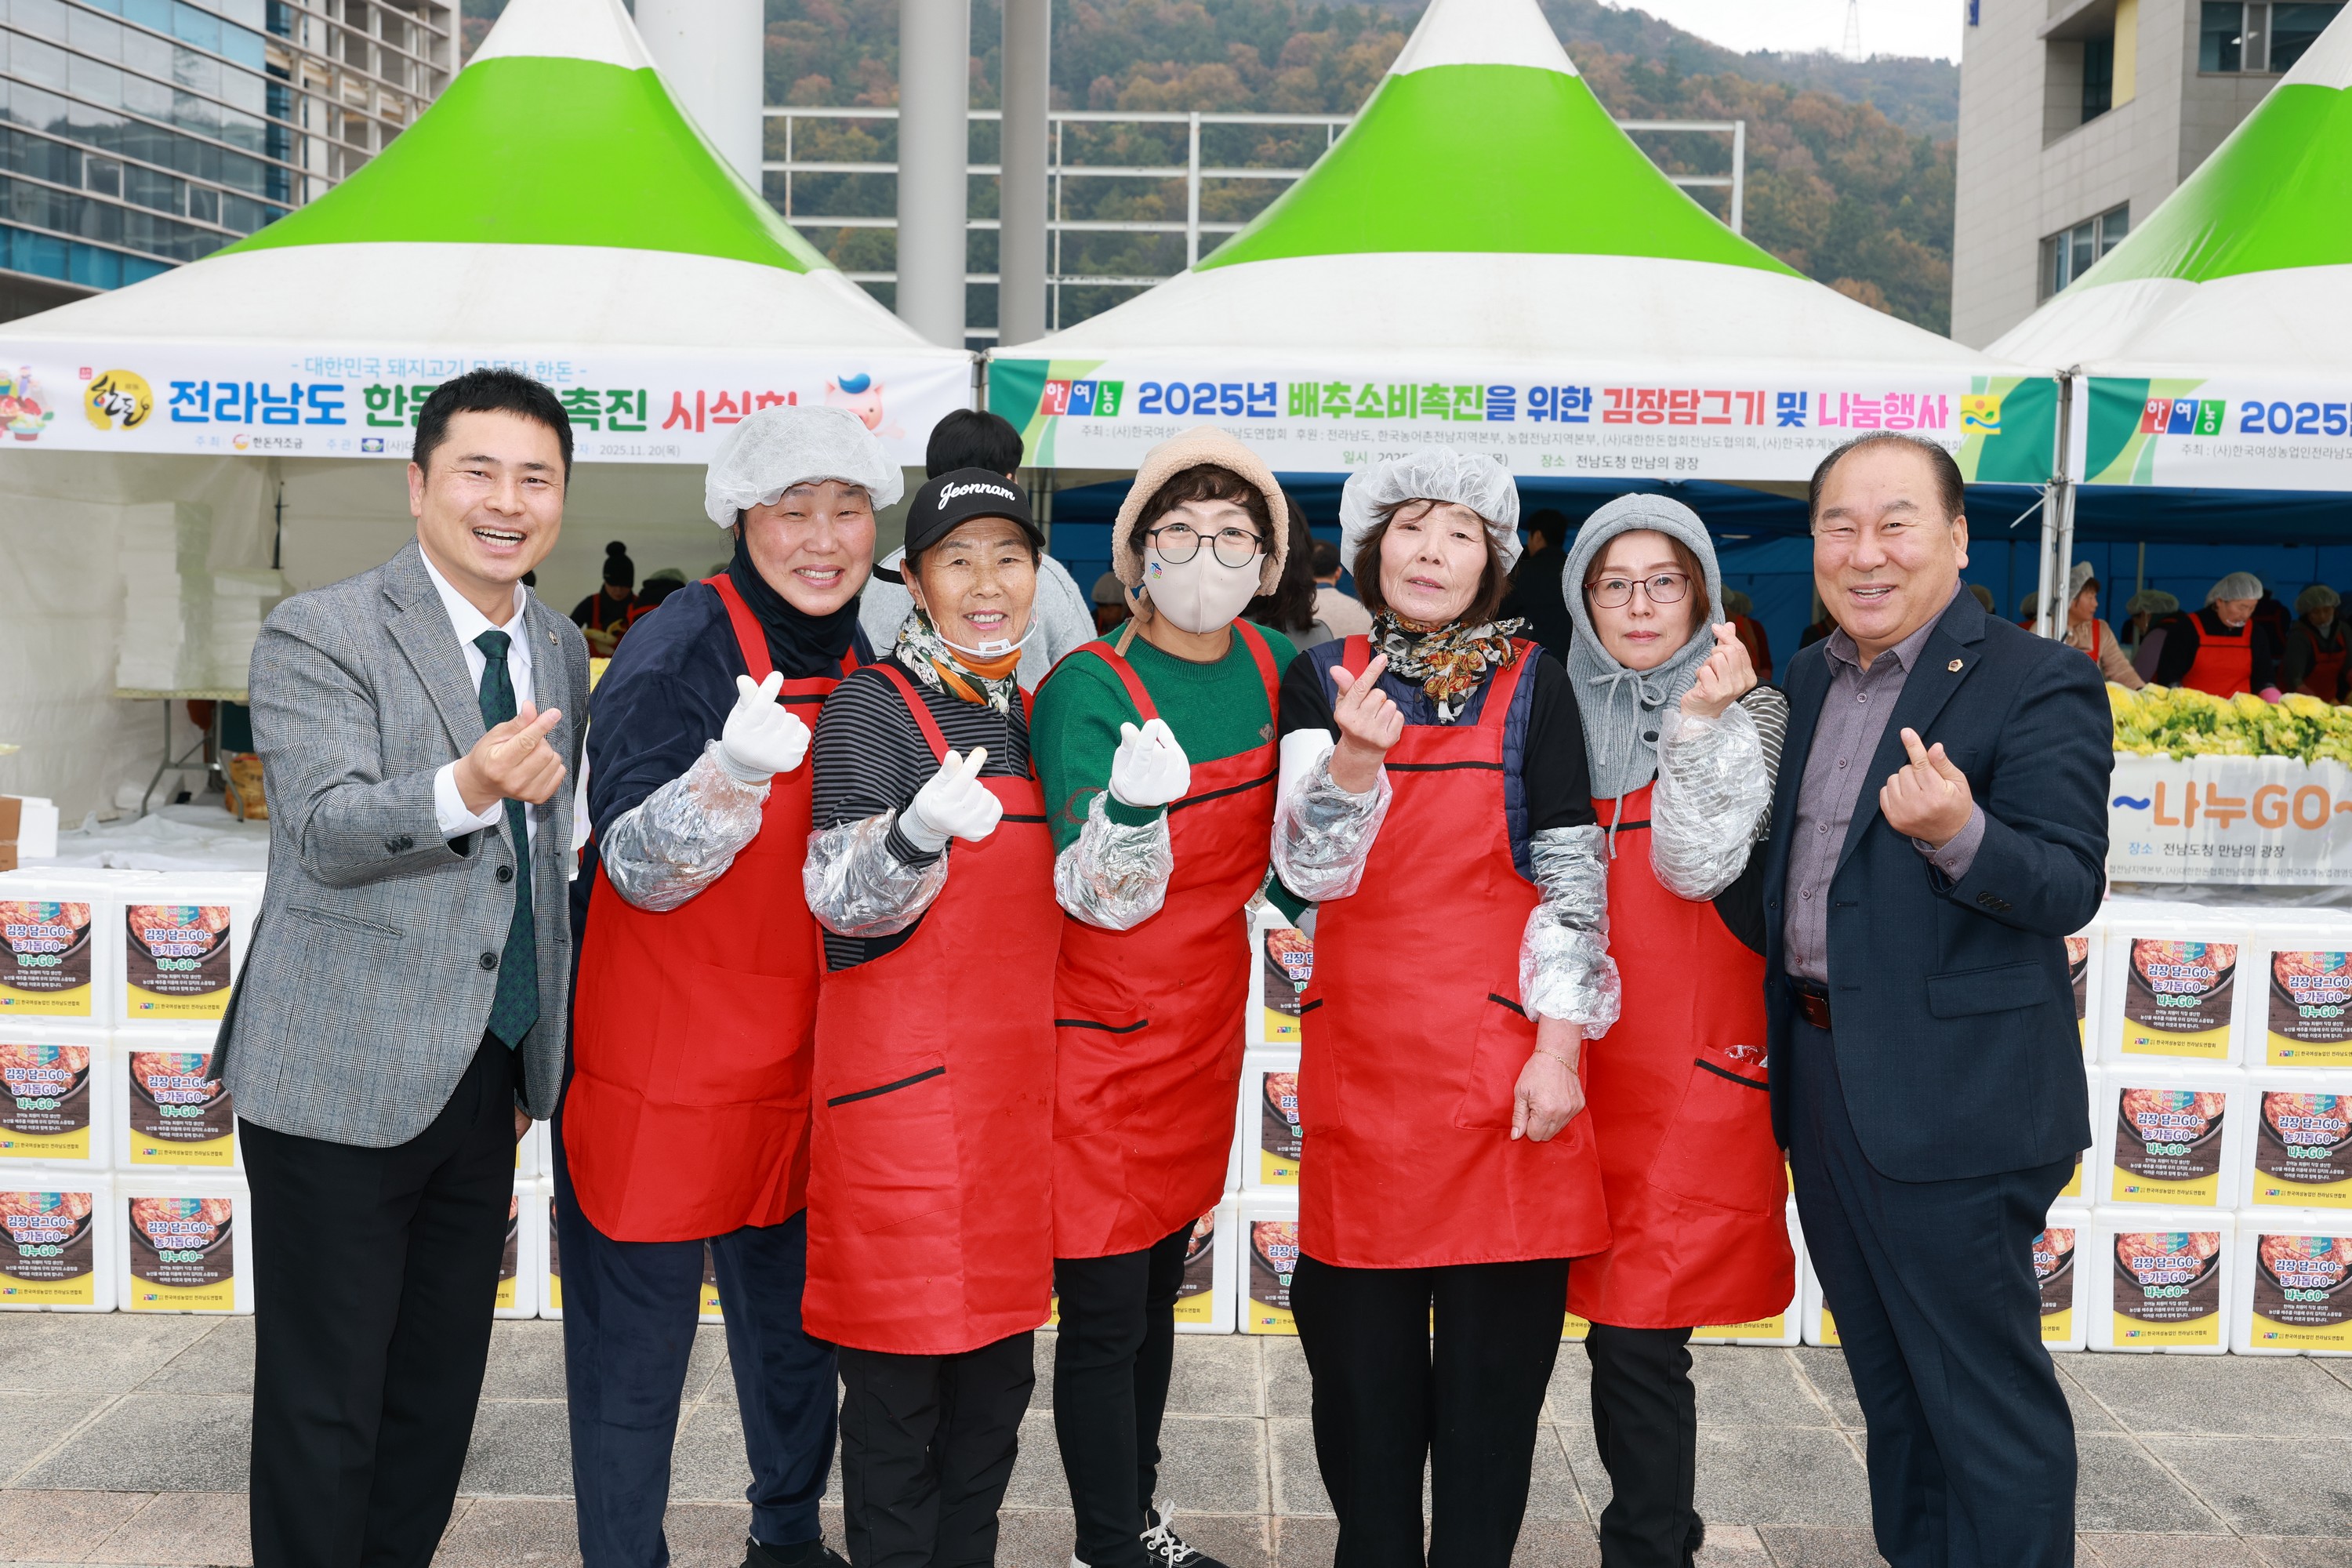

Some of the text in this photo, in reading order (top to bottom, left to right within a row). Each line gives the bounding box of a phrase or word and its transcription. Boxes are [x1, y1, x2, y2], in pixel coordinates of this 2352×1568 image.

[304, 355, 381, 378] 대한민국
[387, 358, 465, 379] 돼지고기
[168, 379, 347, 426] 전라남도
[550, 387, 647, 432] 촉진
[1045, 381, 1949, 430] 한여농 2025년 배추소비촉진을 위한 김장담그기 및 나눔행사
[2146, 399, 2352, 437] 한여농 2025
[252, 437, 303, 450] 한돈자조금
[1342, 450, 1368, 464] 일시
[1541, 454, 1700, 470] 장소 전남도청 만남의 광장
[938, 481, 1016, 510] Jeonnam
[2129, 842, 2285, 858] 장소 전남도청 만남의 광장
[7, 925, 72, 936] 김장 담그GO~
[146, 930, 212, 940] 김장 담그GO~
[13, 940, 66, 952] 농가돕GO~
[152, 945, 205, 955] 농가돕GO~
[18, 955, 61, 966] 나누GO~
[1283, 953, 1305, 964] 김장
[158, 960, 201, 970] 나누GO~
[2147, 964, 2216, 978] 김장 담그GO~
[2153, 980, 2208, 993] 농가돕GO~
[2289, 976, 2310, 987] 김장
[2157, 995, 2201, 1007] 나누GO~
[2295, 991, 2350, 1003] 농가돕GO~
[2299, 1006, 2344, 1018] 나누GO~
[5, 1069, 71, 1080] 김장 담그GO~
[149, 1076, 169, 1087] 김장
[12, 1083, 64, 1095] 농가돕GO~
[155, 1091, 208, 1102] 농가돕GO~
[17, 1098, 60, 1109] 나누GO~
[161, 1106, 204, 1117] 나누GO~
[2137, 1113, 2205, 1126] 김장 담그GO~
[2278, 1116, 2347, 1130] 김장 담그GO~
[2143, 1128, 2197, 1141] 농가돕GO~
[2284, 1132, 2338, 1145] 농가돕GO~
[2147, 1144, 2191, 1156] 나누GO~
[2287, 1147, 2332, 1159] 나누GO~
[8, 1216, 74, 1227] 김장 담그GO~
[148, 1222, 213, 1232] 김장 담그GO~
[15, 1231, 67, 1242] 농가돕GO~
[154, 1236, 207, 1247] 농가돕GO~
[20, 1246, 63, 1256] 나누GO~
[160, 1251, 203, 1262] 나누GO~
[1269, 1245, 1290, 1257] 김장
[2033, 1253, 2056, 1263] GO~
[2133, 1256, 2201, 1269] 김장 담그GO~
[2275, 1260, 2343, 1272] 김장 담그GO~
[2140, 1271, 2194, 1283] 농가돕GO~
[2281, 1275, 2335, 1287] 농가돕GO~
[2144, 1286, 2189, 1298] 나누GO~
[2285, 1290, 2329, 1301] 나누GO~
